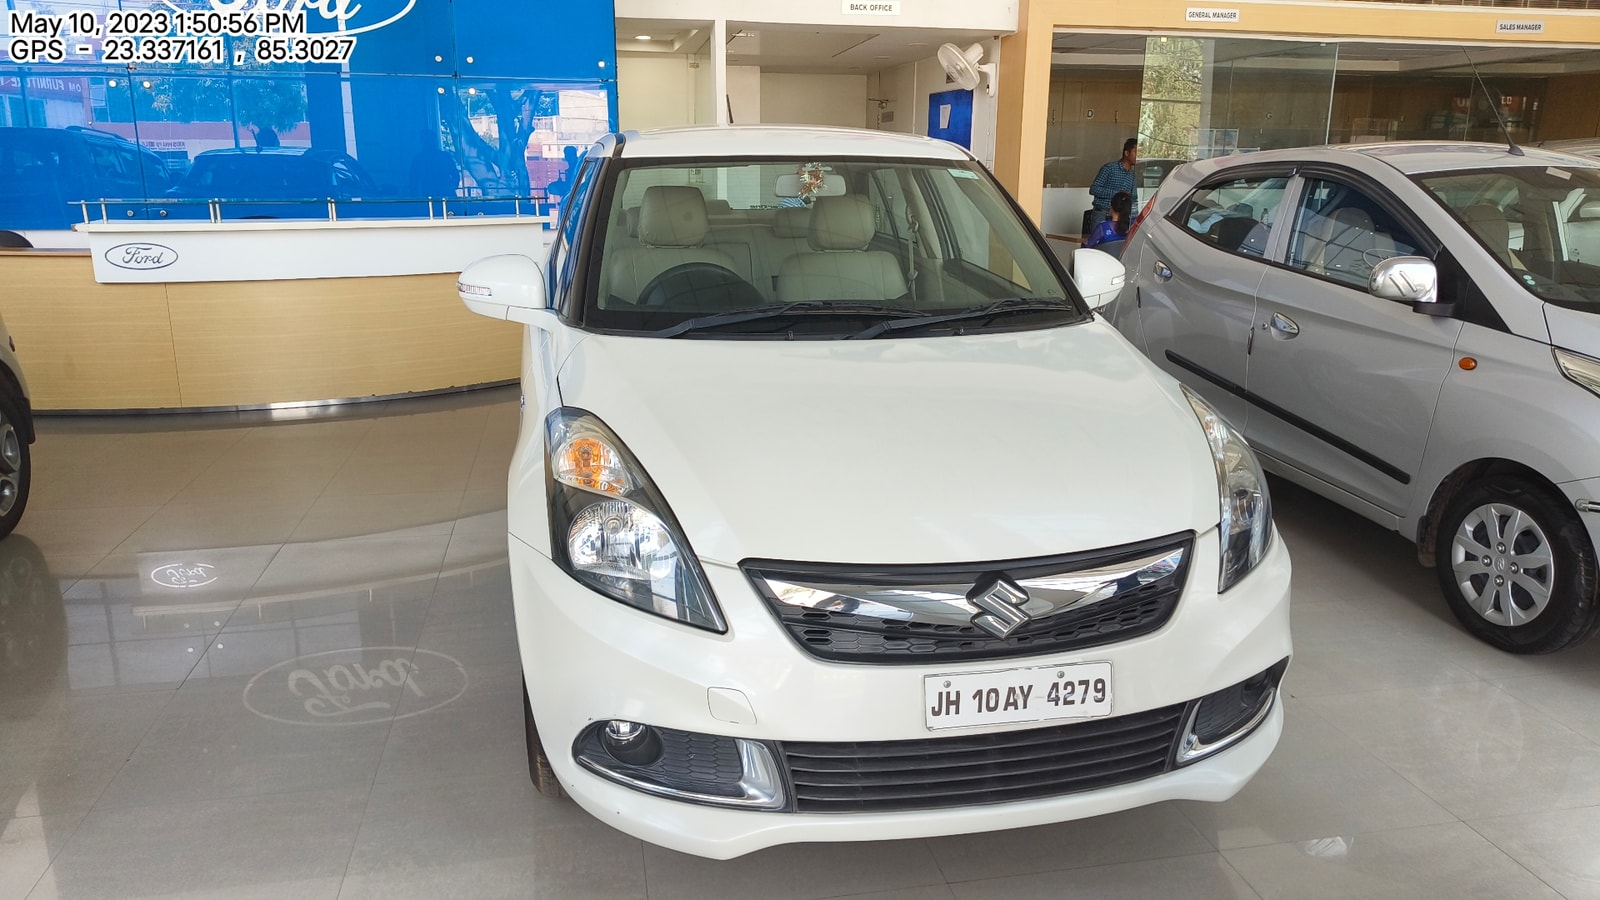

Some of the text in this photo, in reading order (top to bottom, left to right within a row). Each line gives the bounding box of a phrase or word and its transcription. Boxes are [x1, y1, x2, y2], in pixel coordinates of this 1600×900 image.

[869, 4, 893, 12] OFFICE
[1188, 11, 1211, 19] GENERAL
[1499, 23, 1542, 31] SALES MANAGER
[122, 246, 164, 264] Ford
[931, 690, 961, 717] JH
[1047, 677, 1107, 707] 4279
